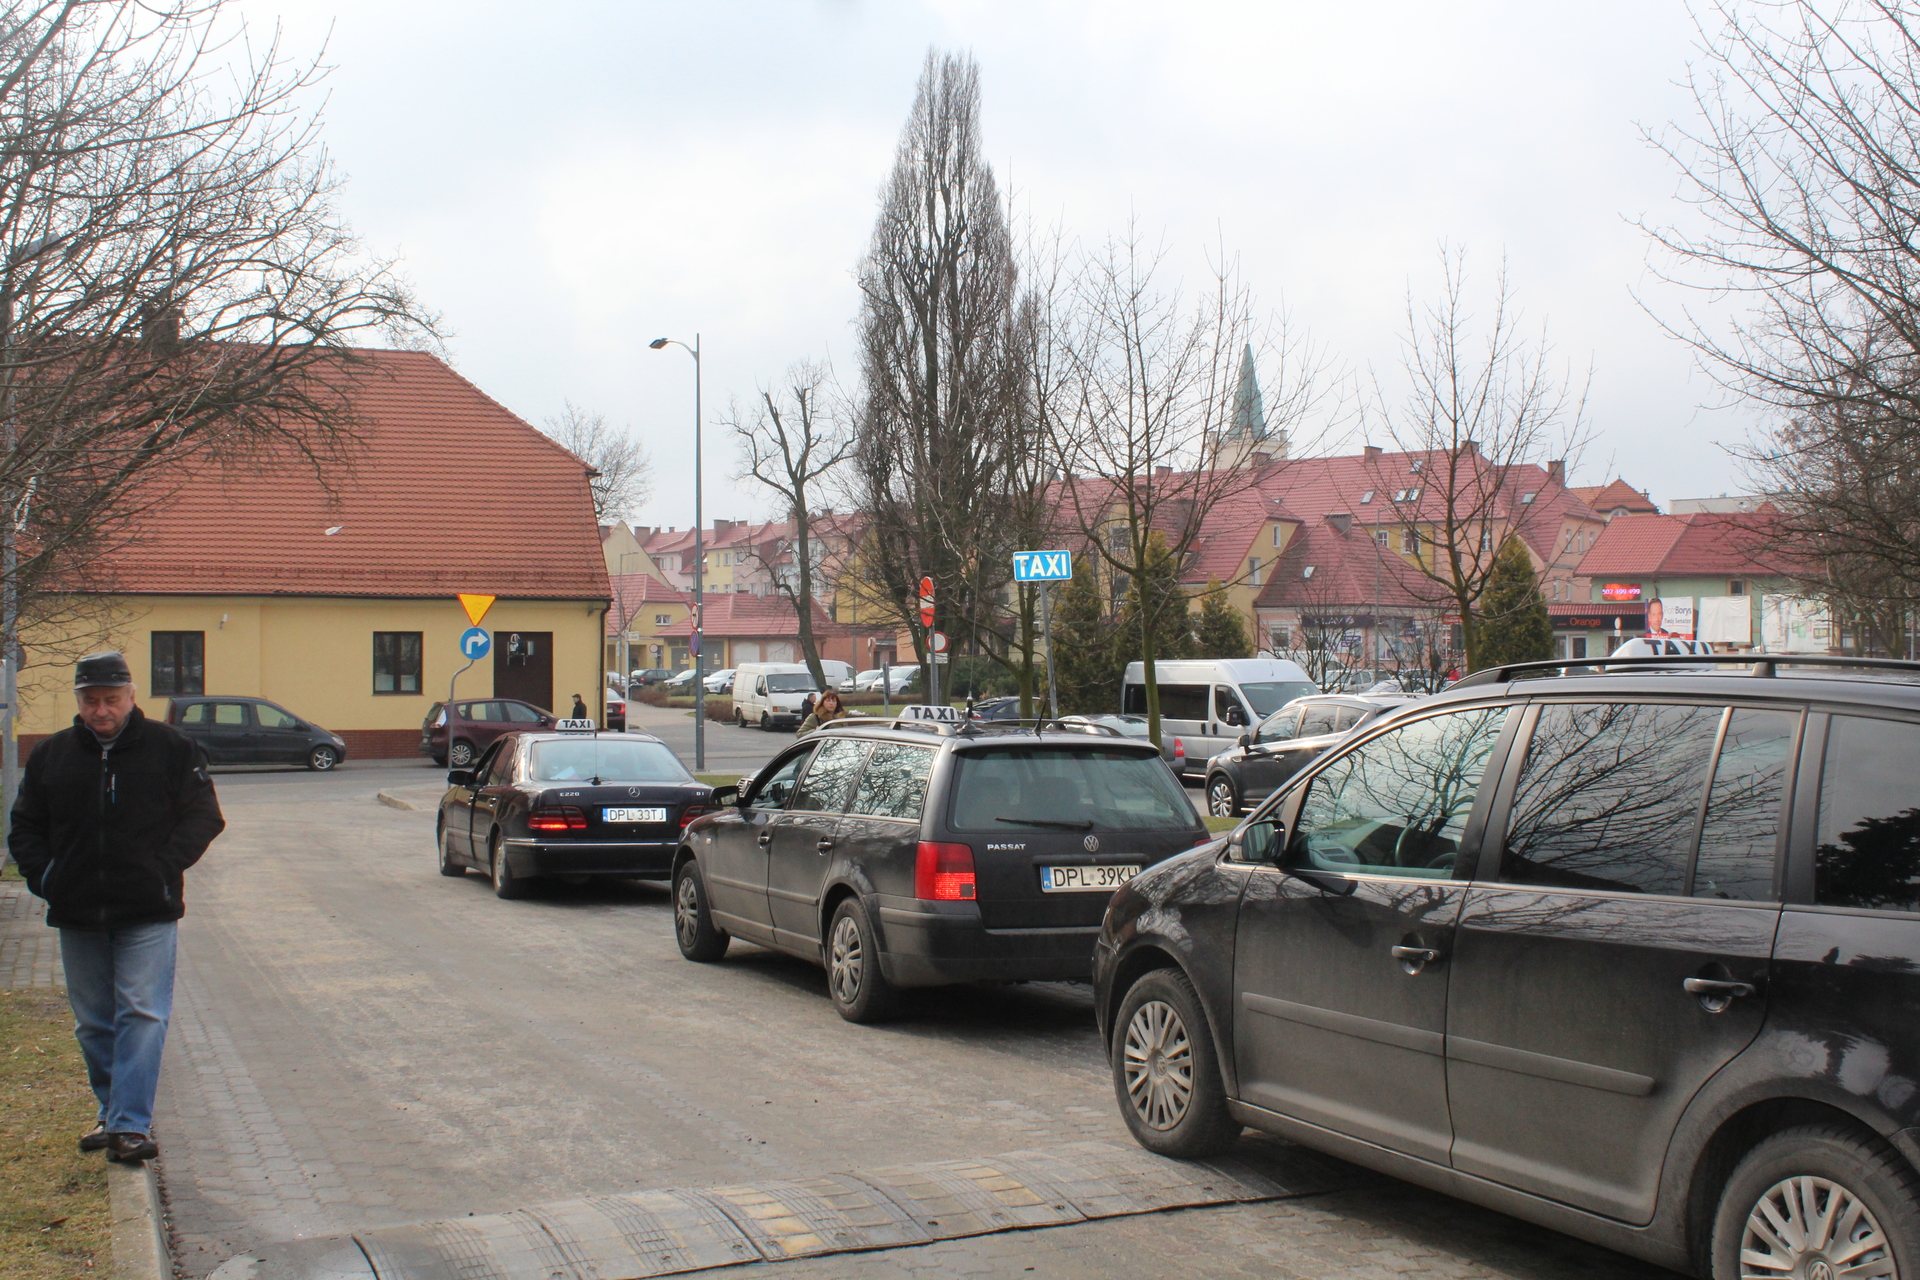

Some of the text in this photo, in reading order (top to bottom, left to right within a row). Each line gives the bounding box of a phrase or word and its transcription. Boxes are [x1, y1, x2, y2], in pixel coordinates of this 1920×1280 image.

[1015, 554, 1067, 577] TAXI
[1675, 605, 1691, 616] Borys
[1570, 617, 1601, 627] Orange
[1643, 639, 1709, 655] TAXI
[910, 707, 955, 720] TAXI
[562, 720, 590, 728] TAXI
[609, 809, 634, 821] DPL
[637, 809, 664, 821] 33TJ
[987, 843, 1026, 851] PASSAT
[1053, 868, 1090, 887] DPL
